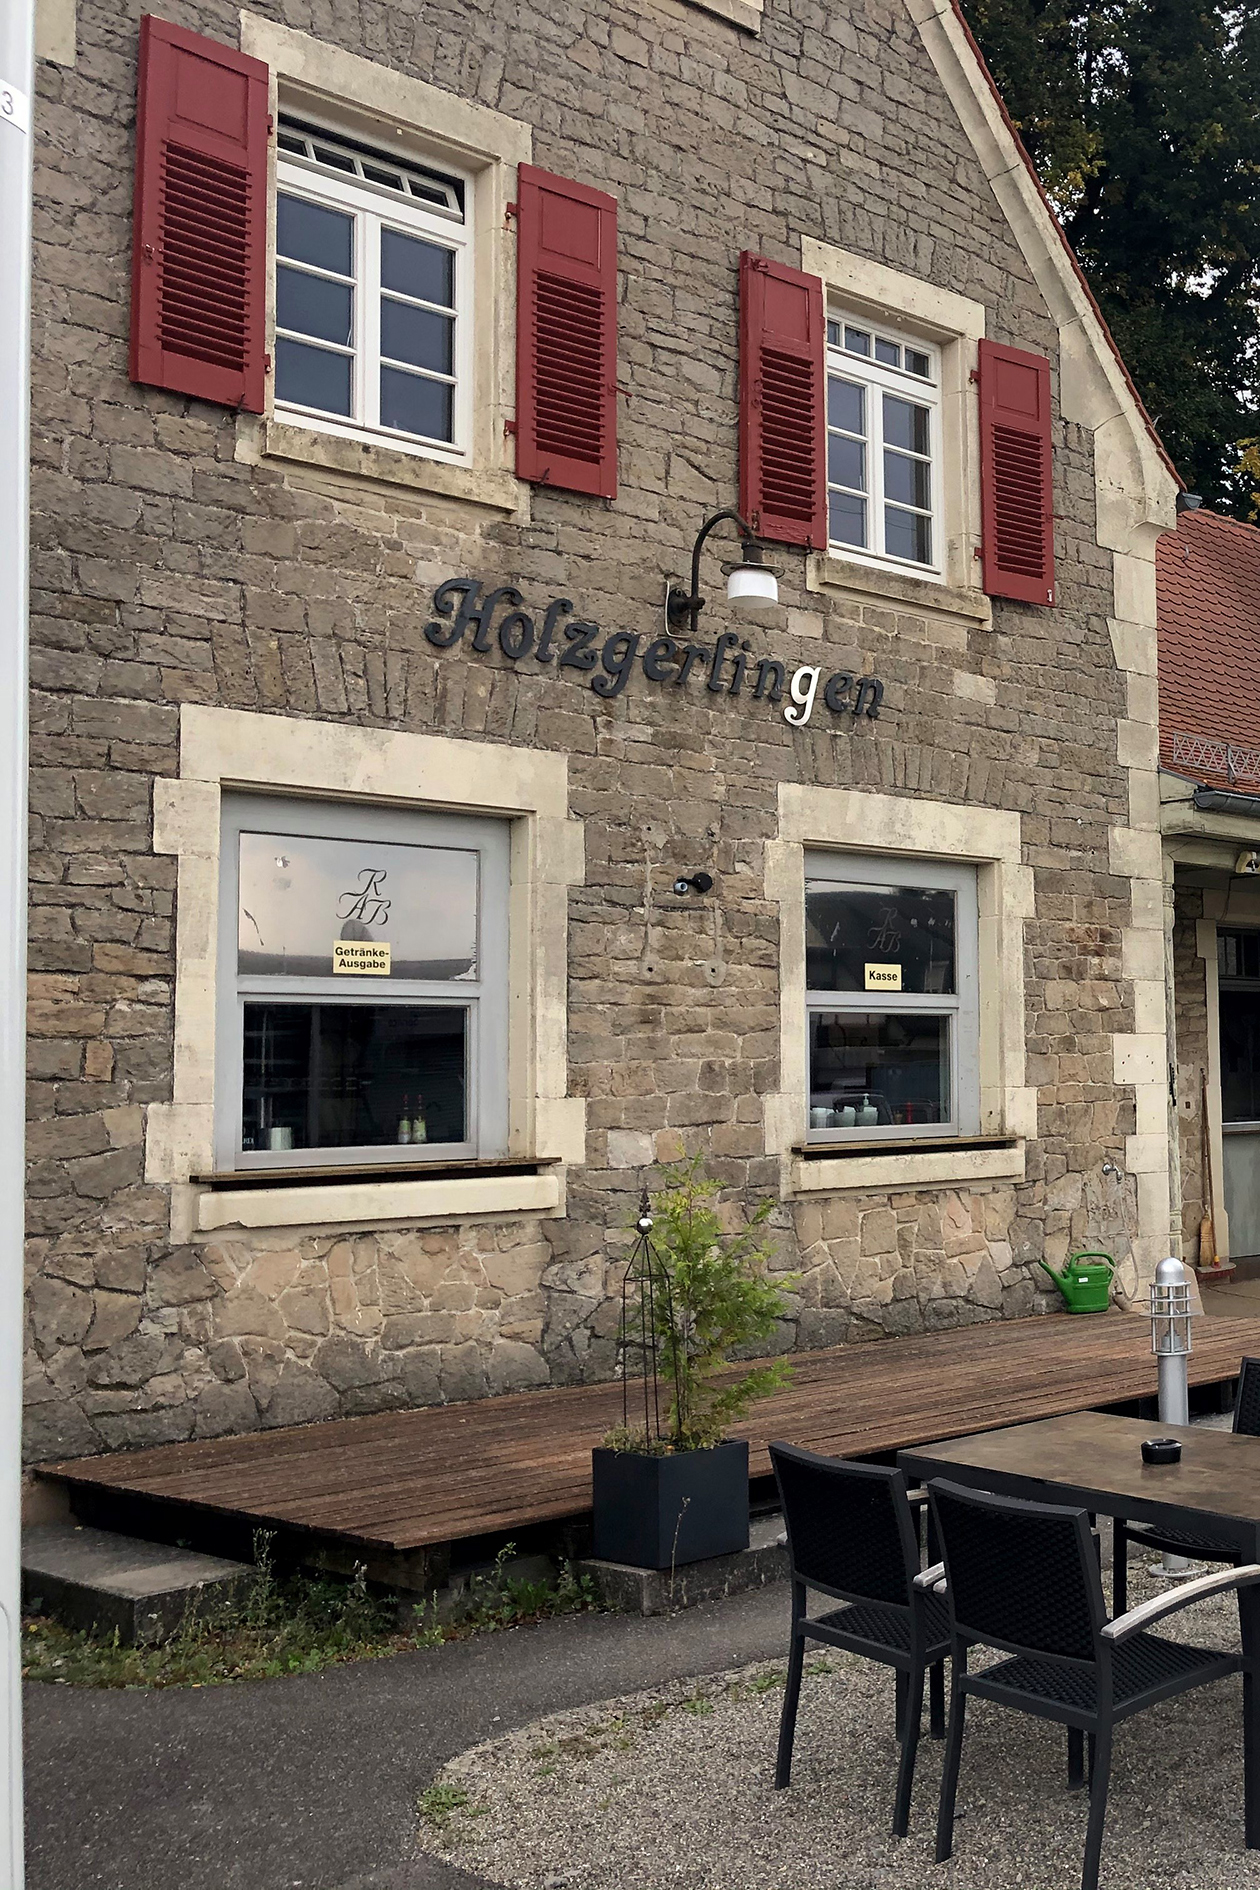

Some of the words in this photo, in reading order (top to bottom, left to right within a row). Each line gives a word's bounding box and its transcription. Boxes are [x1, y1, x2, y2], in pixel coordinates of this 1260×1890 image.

[424, 578, 885, 725] Holzgerlingen
[335, 947, 389, 957] Getränke-
[339, 958, 386, 970] Ausgabe
[869, 970, 898, 981] Kasse
